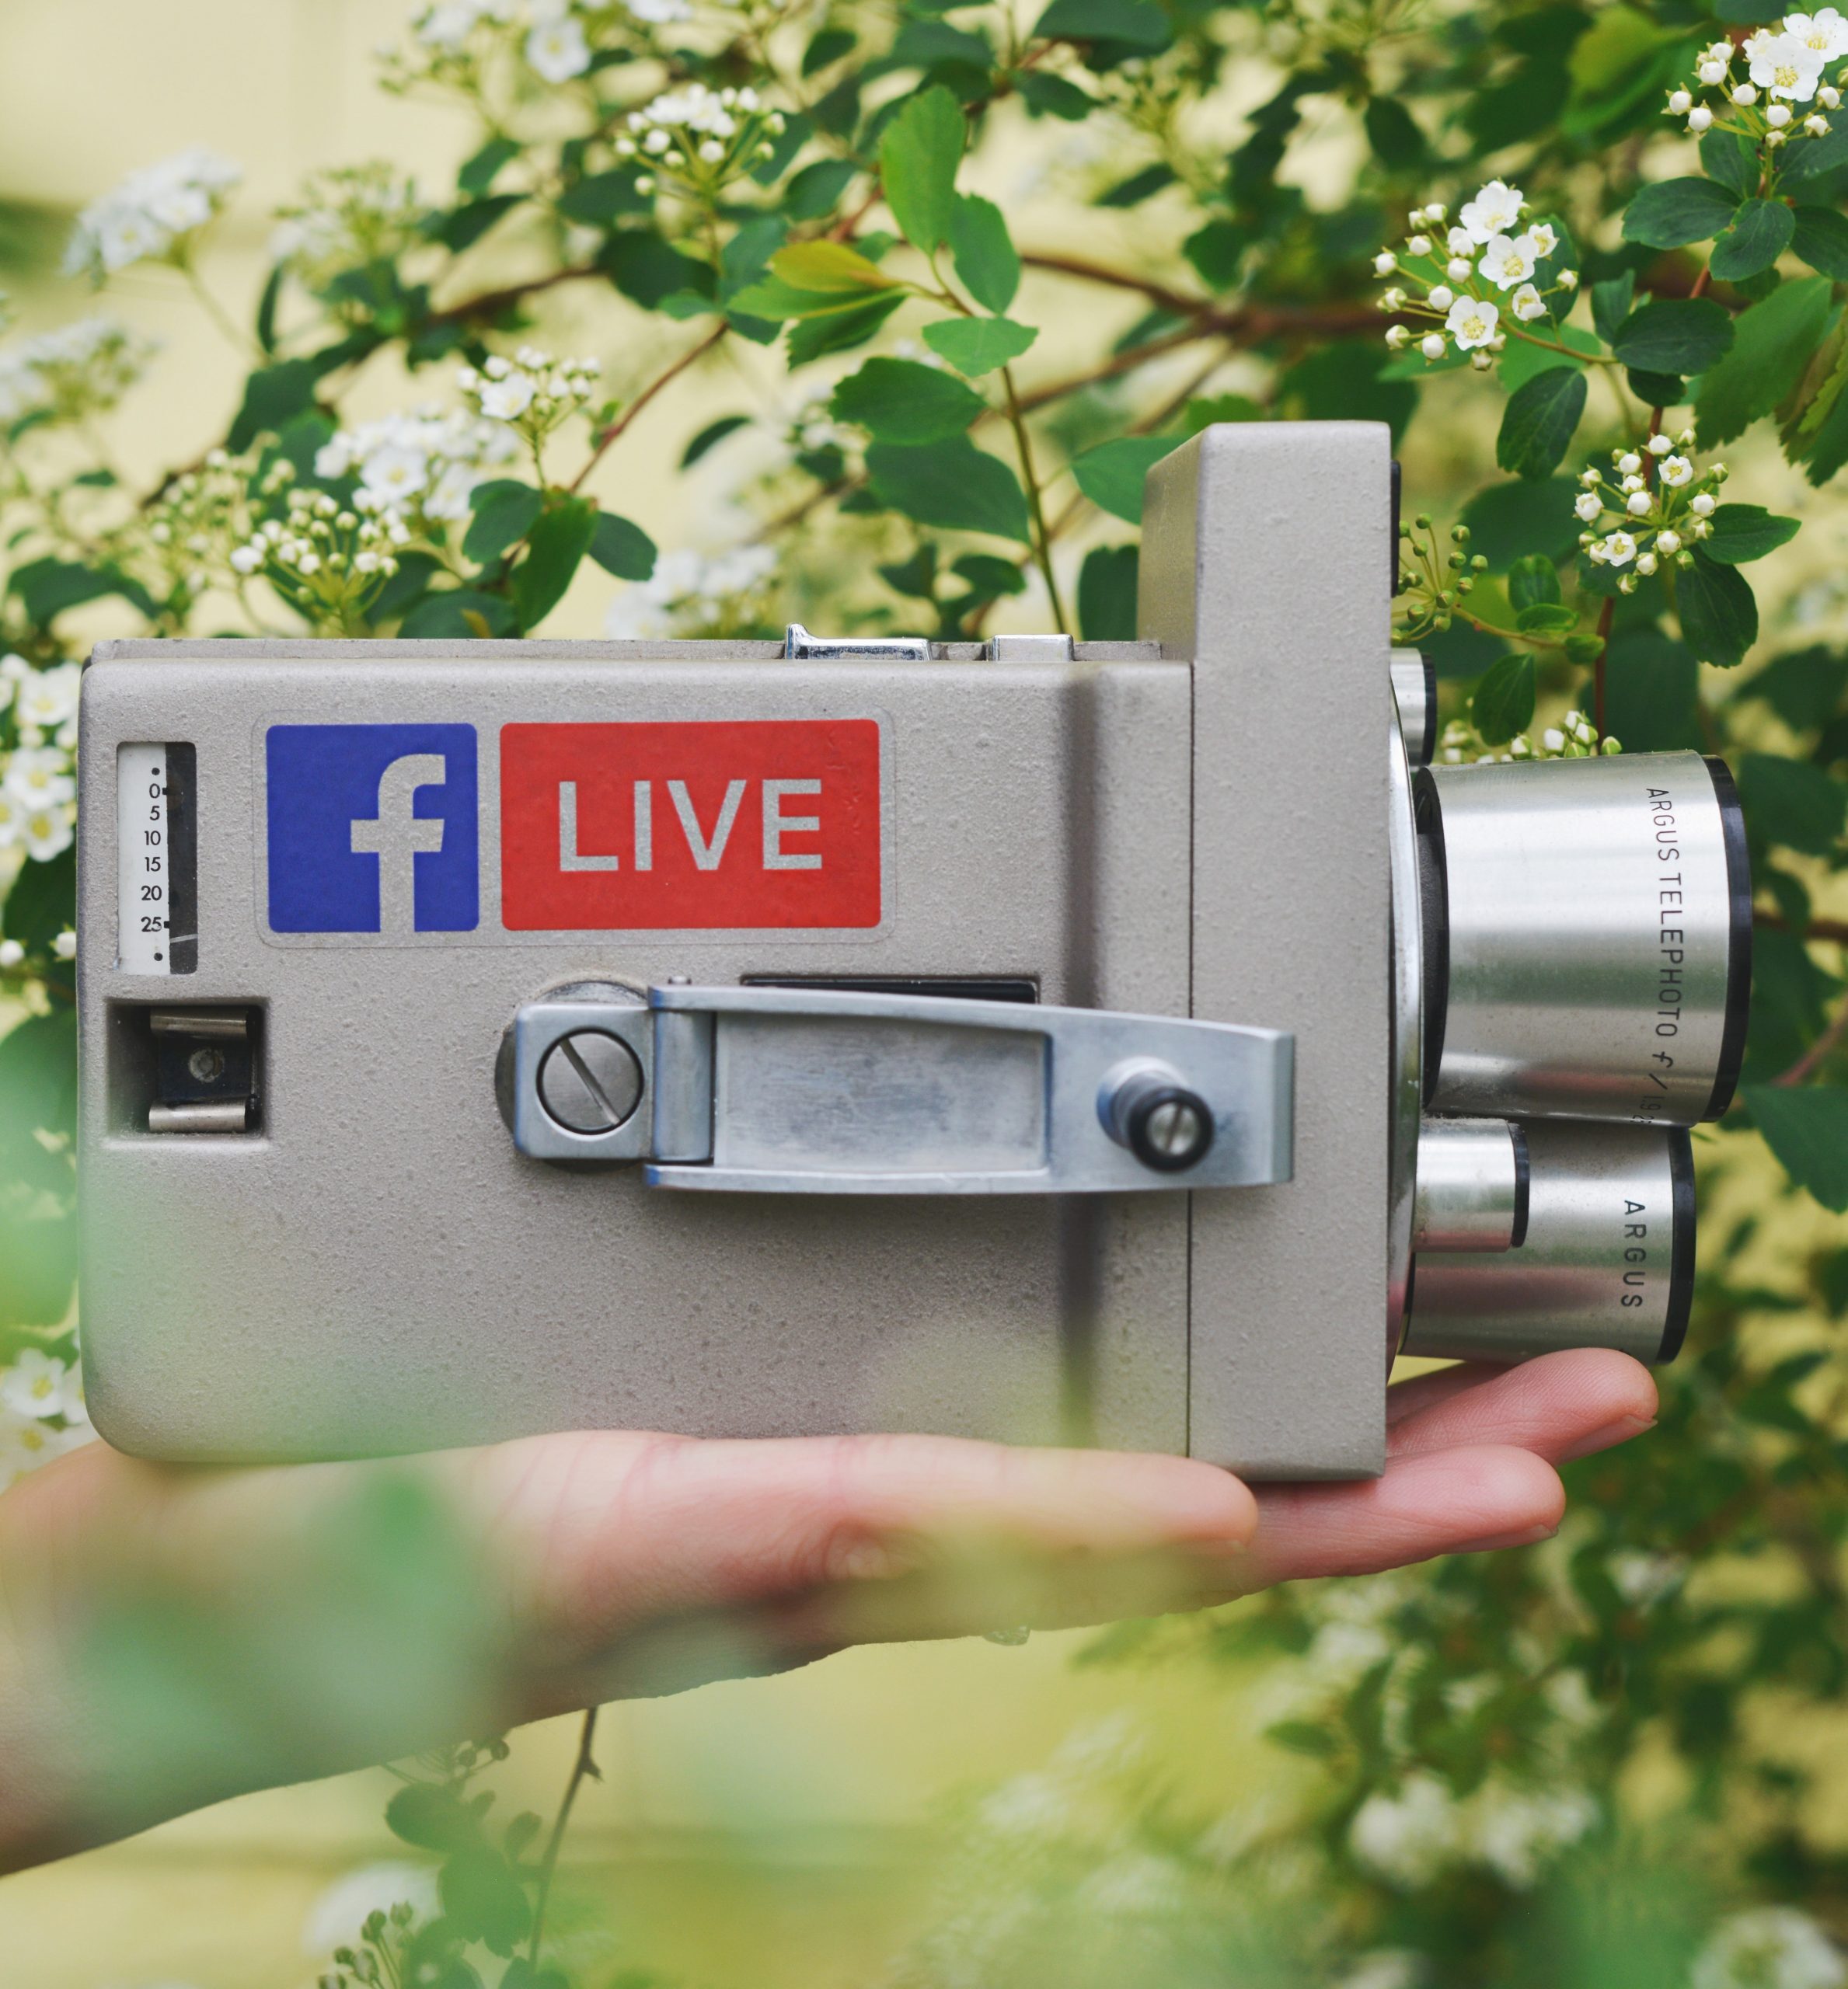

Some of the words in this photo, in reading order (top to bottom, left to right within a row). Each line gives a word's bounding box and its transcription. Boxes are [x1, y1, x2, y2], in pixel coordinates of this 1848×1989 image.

[148, 783, 161, 799] 0
[149, 805, 160, 820] 5
[560, 779, 822, 872] LIVE
[1645, 788, 1679, 862] ARGUS
[144, 831, 161, 845] 10
[144, 856, 161, 872] 15
[141, 885, 162, 901] 20
[140, 916, 162, 932] 25
[1655, 872, 1684, 1038] TELEPHOTO
[1620, 1200, 1647, 1308] ARGUS
